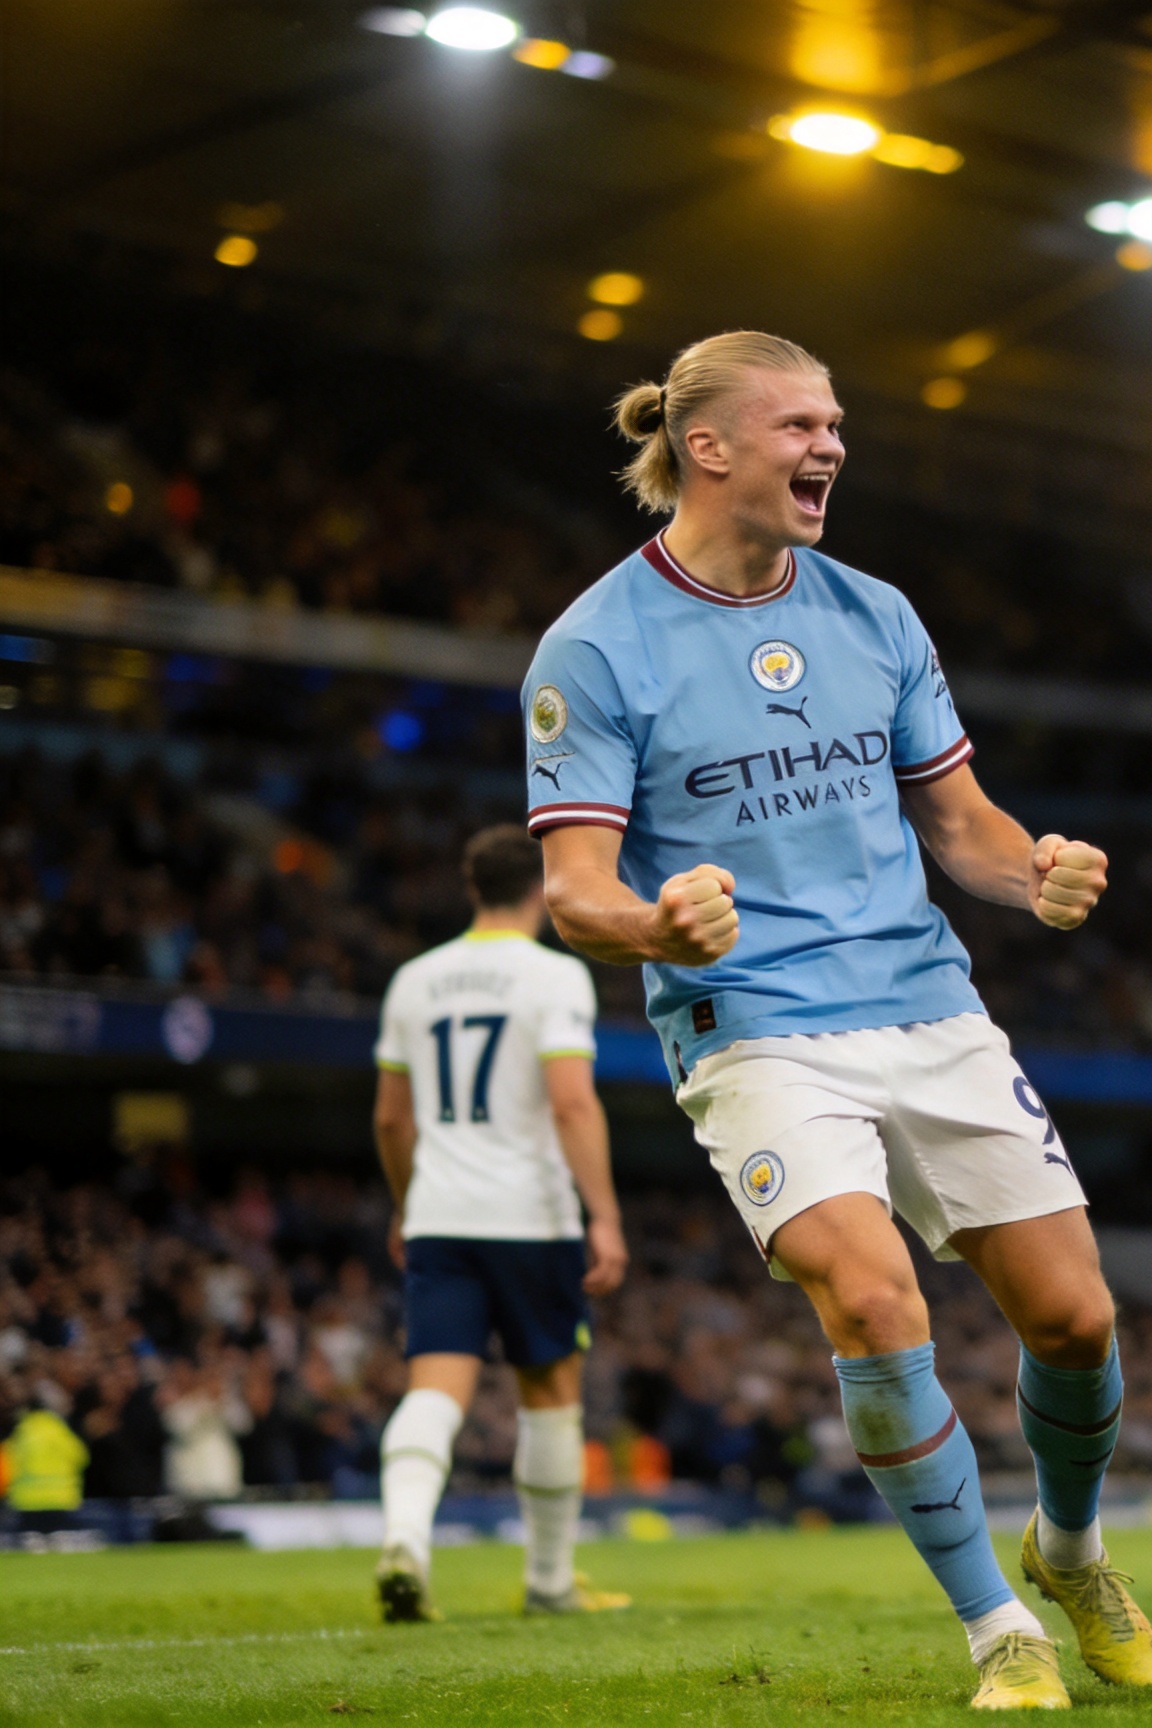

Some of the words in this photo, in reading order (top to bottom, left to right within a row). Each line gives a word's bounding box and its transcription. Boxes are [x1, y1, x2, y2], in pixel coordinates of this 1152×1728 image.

[684, 730, 888, 799] ETIHAD
[735, 775, 871, 827] AIRWAYS
[430, 1014, 509, 1123] 17
[1012, 1076, 1055, 1145] 9
